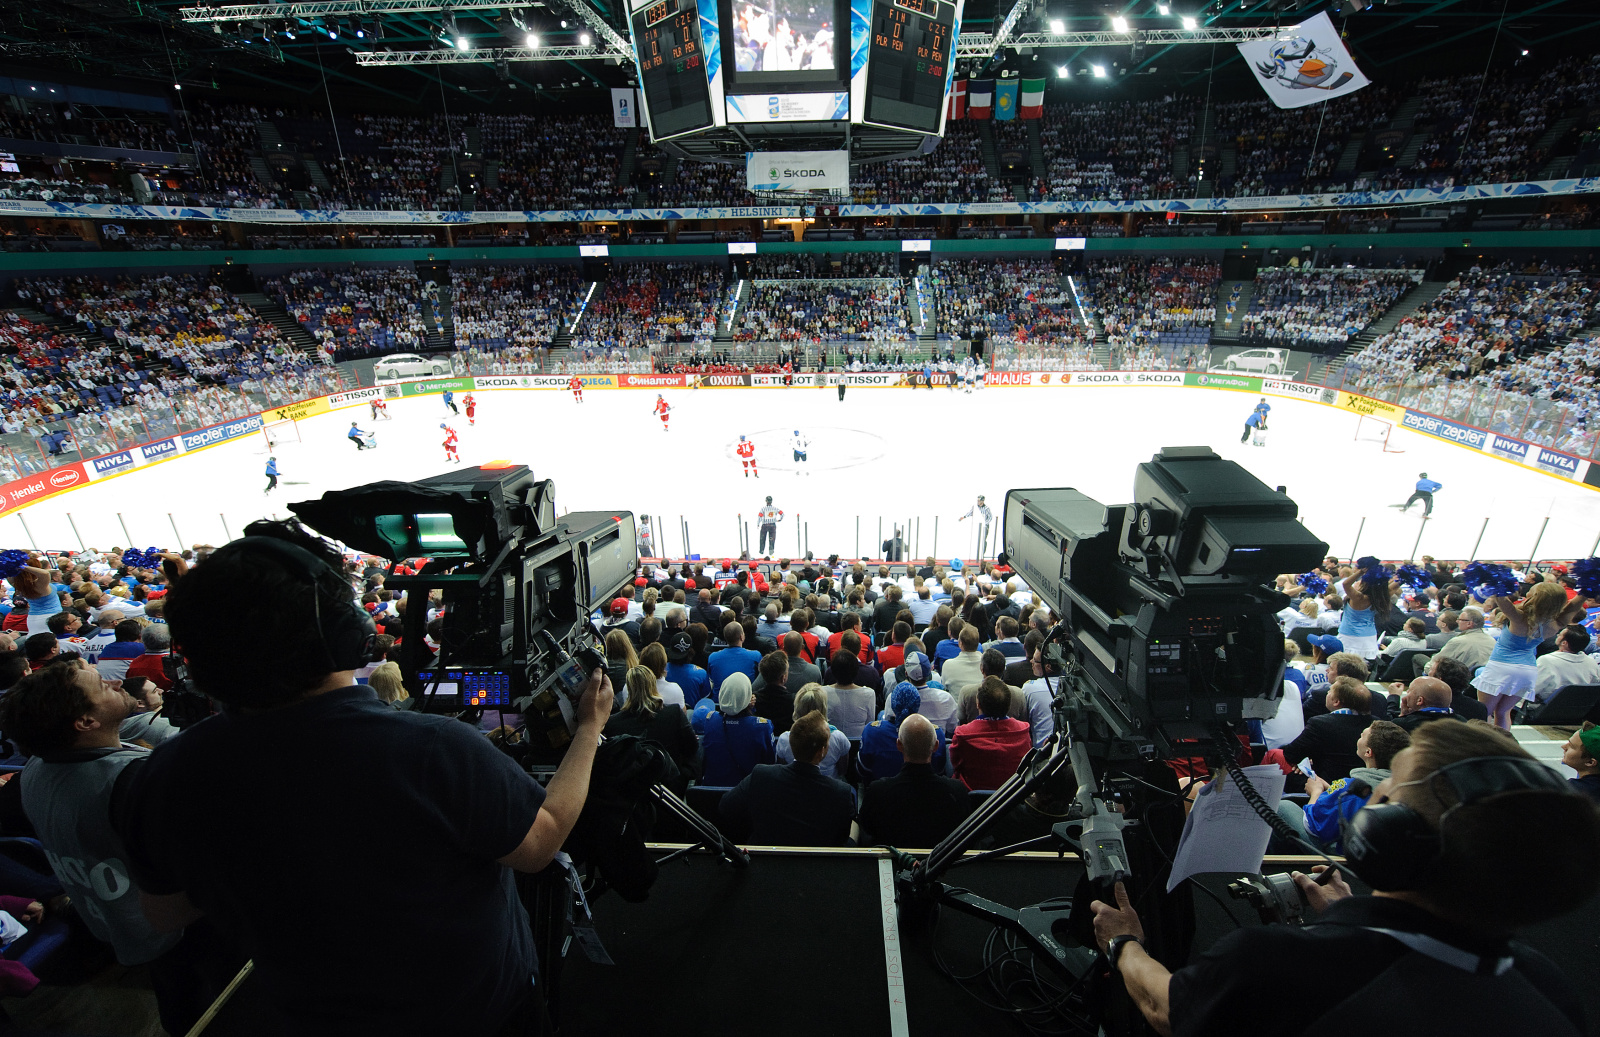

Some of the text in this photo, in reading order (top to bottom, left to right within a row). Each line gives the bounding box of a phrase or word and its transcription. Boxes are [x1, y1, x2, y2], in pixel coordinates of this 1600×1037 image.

[675, 12, 691, 28] CZE
[889, 8, 906, 23] FIN
[683, 26, 689, 42] 0
[893, 22, 901, 39] 0
[928, 22, 946, 36] CZE
[652, 41, 657, 56] 0
[672, 41, 695, 58] PLR PEN
[876, 34, 904, 51] PLR PEN
[933, 35, 941, 50] 0
[918, 46, 942, 62] PLR PEN
[643, 55, 663, 70] PLR PEN
[783, 168, 826, 178] ŠKODA
[731, 207, 782, 217] HELSINKI
[477, 378, 518, 387] ŠKODA
[709, 375, 745, 386] ОХОТА
[847, 376, 889, 384] TISSOT
[1077, 374, 1119, 383] ŠKODA
[1138, 374, 1181, 383] ŠKODA
[344, 388, 382, 400] TISSOT
[1281, 382, 1320, 395] TISSOT
[287, 401, 316, 412] Raiffeisen
[1357, 407, 1374, 415] БАНК
[290, 410, 307, 420] BANK
[1405, 412, 1443, 431] zepter
[226, 416, 262, 435] zepter
[184, 428, 225, 449] zepter
[1443, 424, 1486, 444] zepter
[144, 442, 175, 456] NIVEA
[1495, 437, 1525, 455] NIVEA
[97, 453, 131, 471] NIVEA
[1541, 452, 1575, 470] NIVEA
[10, 481, 46, 501] Henkel
[882, 871, 903, 987] HOST BROADCAST
